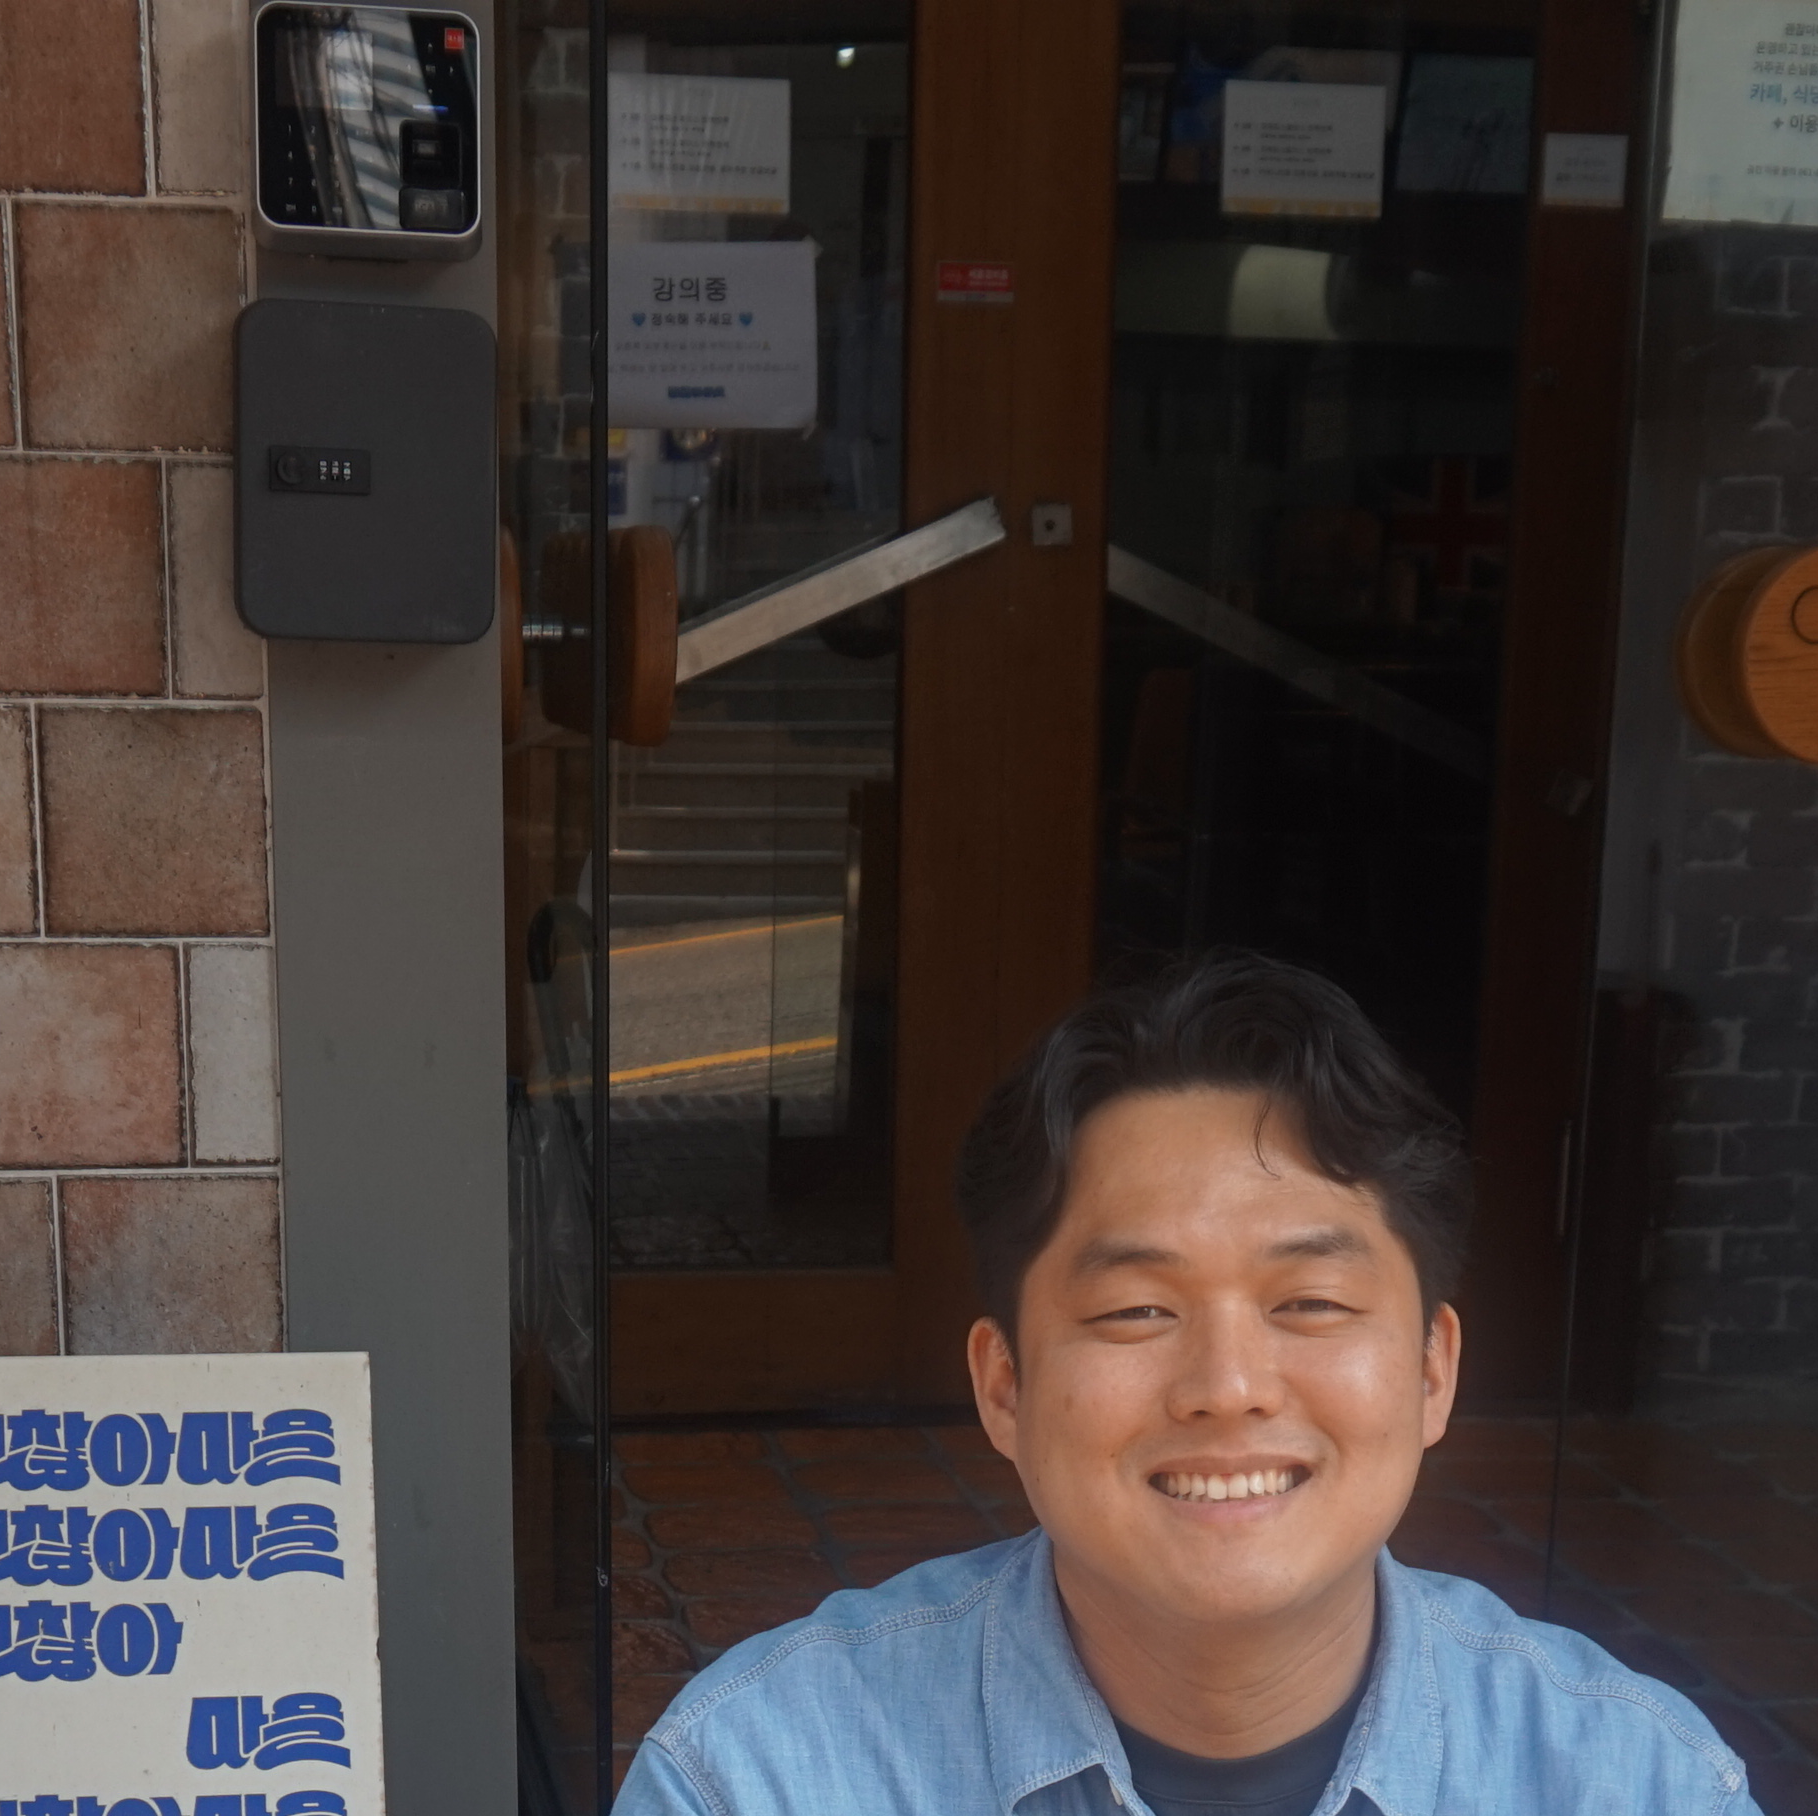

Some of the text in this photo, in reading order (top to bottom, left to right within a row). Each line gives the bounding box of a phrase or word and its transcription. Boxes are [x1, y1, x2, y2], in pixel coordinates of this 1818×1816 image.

[1749, 83, 1787, 105] 카페,
[653, 277, 726, 302] 강의중
[695, 313, 732, 326] 주세요
[186, 1692, 351, 1770] 마을
